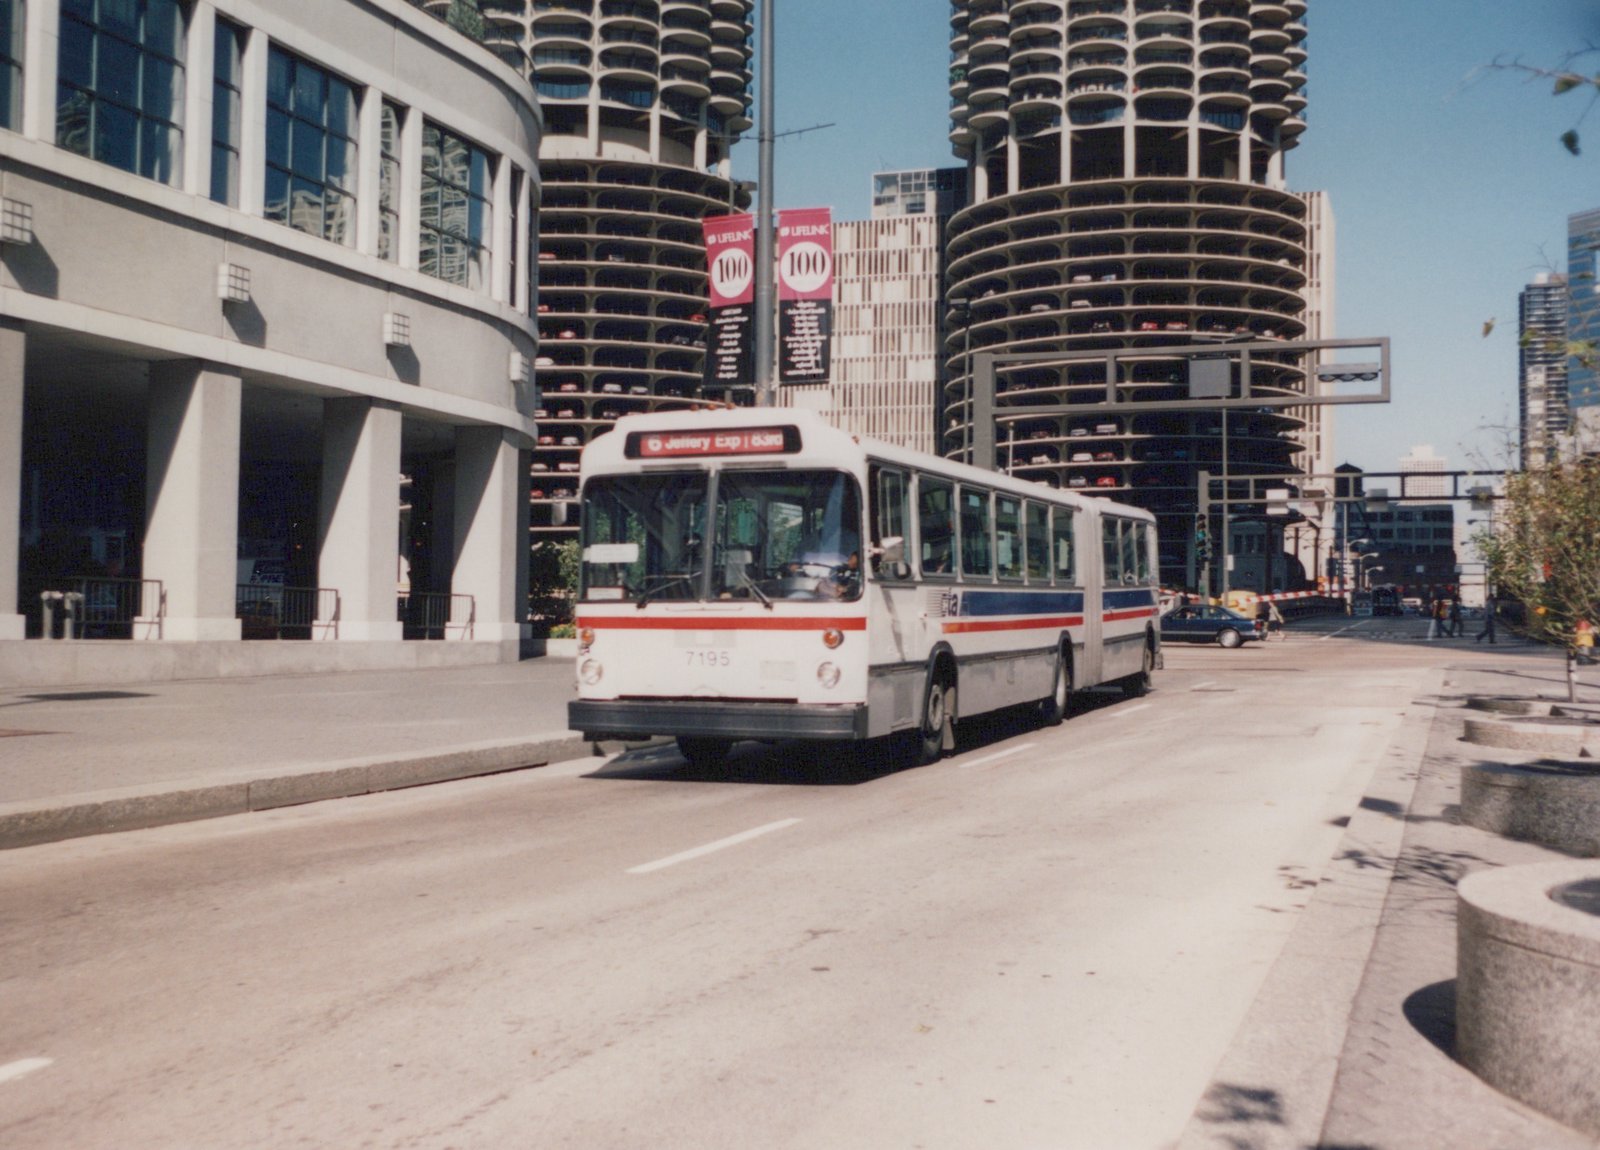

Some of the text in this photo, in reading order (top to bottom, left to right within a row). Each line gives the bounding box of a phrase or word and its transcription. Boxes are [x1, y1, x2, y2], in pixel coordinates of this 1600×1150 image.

[717, 228, 753, 243] LIFELINK
[791, 224, 829, 237] LIFELINK
[717, 254, 748, 284] 100
[788, 249, 826, 277] 100
[714, 435, 742, 451] Exp
[685, 650, 730, 667] 7195
